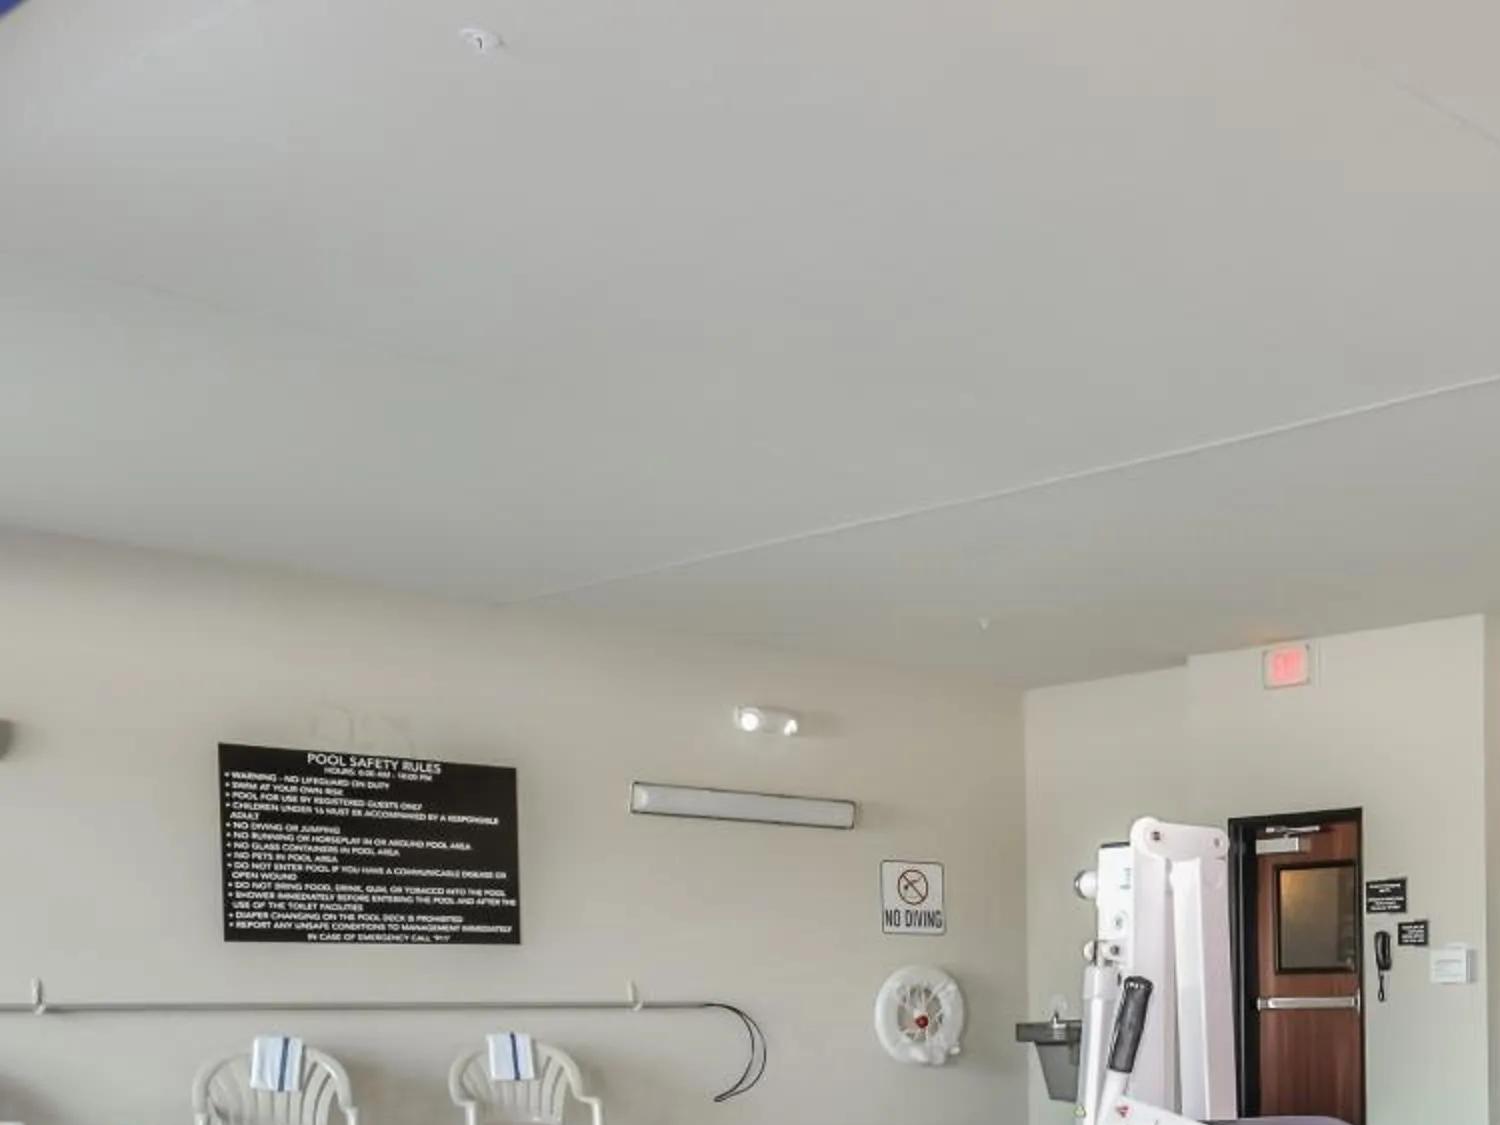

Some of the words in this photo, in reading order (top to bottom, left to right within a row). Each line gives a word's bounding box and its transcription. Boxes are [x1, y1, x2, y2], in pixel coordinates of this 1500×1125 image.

[307, 754, 346, 766] POOL
[349, 757, 398, 770] SAFETY
[401, 762, 441, 773] RULES
[231, 771, 276, 782] WARNING
[283, 775, 299, 783] NO
[301, 776, 349, 787] LIFEGUARD
[367, 781, 389, 789] DUTY
[231, 781, 257, 790] SWIM
[259, 783, 270, 791] AT
[273, 784, 298, 792] YOUR
[299, 786, 323, 794] OWN
[231, 791, 257, 800] POOL
[259, 793, 279, 802] FOR
[281, 795, 298, 803] USE
[299, 796, 312, 804] BY
[313, 797, 364, 807] REGISTERED
[367, 800, 398, 809] GUESTS
[232, 802, 278, 812] CHILDREN
[280, 805, 312, 813] UNDER
[325, 808, 349, 816] MUST
[230, 812, 259, 820] ADULT
[250, 823, 282, 831] DIVING
[285, 824, 298, 832] OR
[300, 825, 340, 834] JUMPING
[251, 833, 294, 842] RUNNING
[387, 840, 424, 848] AROUND
[426, 841, 447, 849] POOL
[251, 842, 280, 850] GLASS
[282, 844, 338, 853] CONTAINERS
[351, 847, 376, 855] POOL
[251, 852, 273, 860] PETS
[275, 853, 285, 861] IN
[287, 854, 312, 862] POOL
[233, 862, 250, 870] DO
[251, 862, 272, 870] NOT
[273, 863, 302, 871] ENTER
[305, 864, 330, 872] POOL
[235, 892, 275, 900] SHOWER
[886, 909, 900, 927] NO
[905, 909, 942, 928] DIVING
